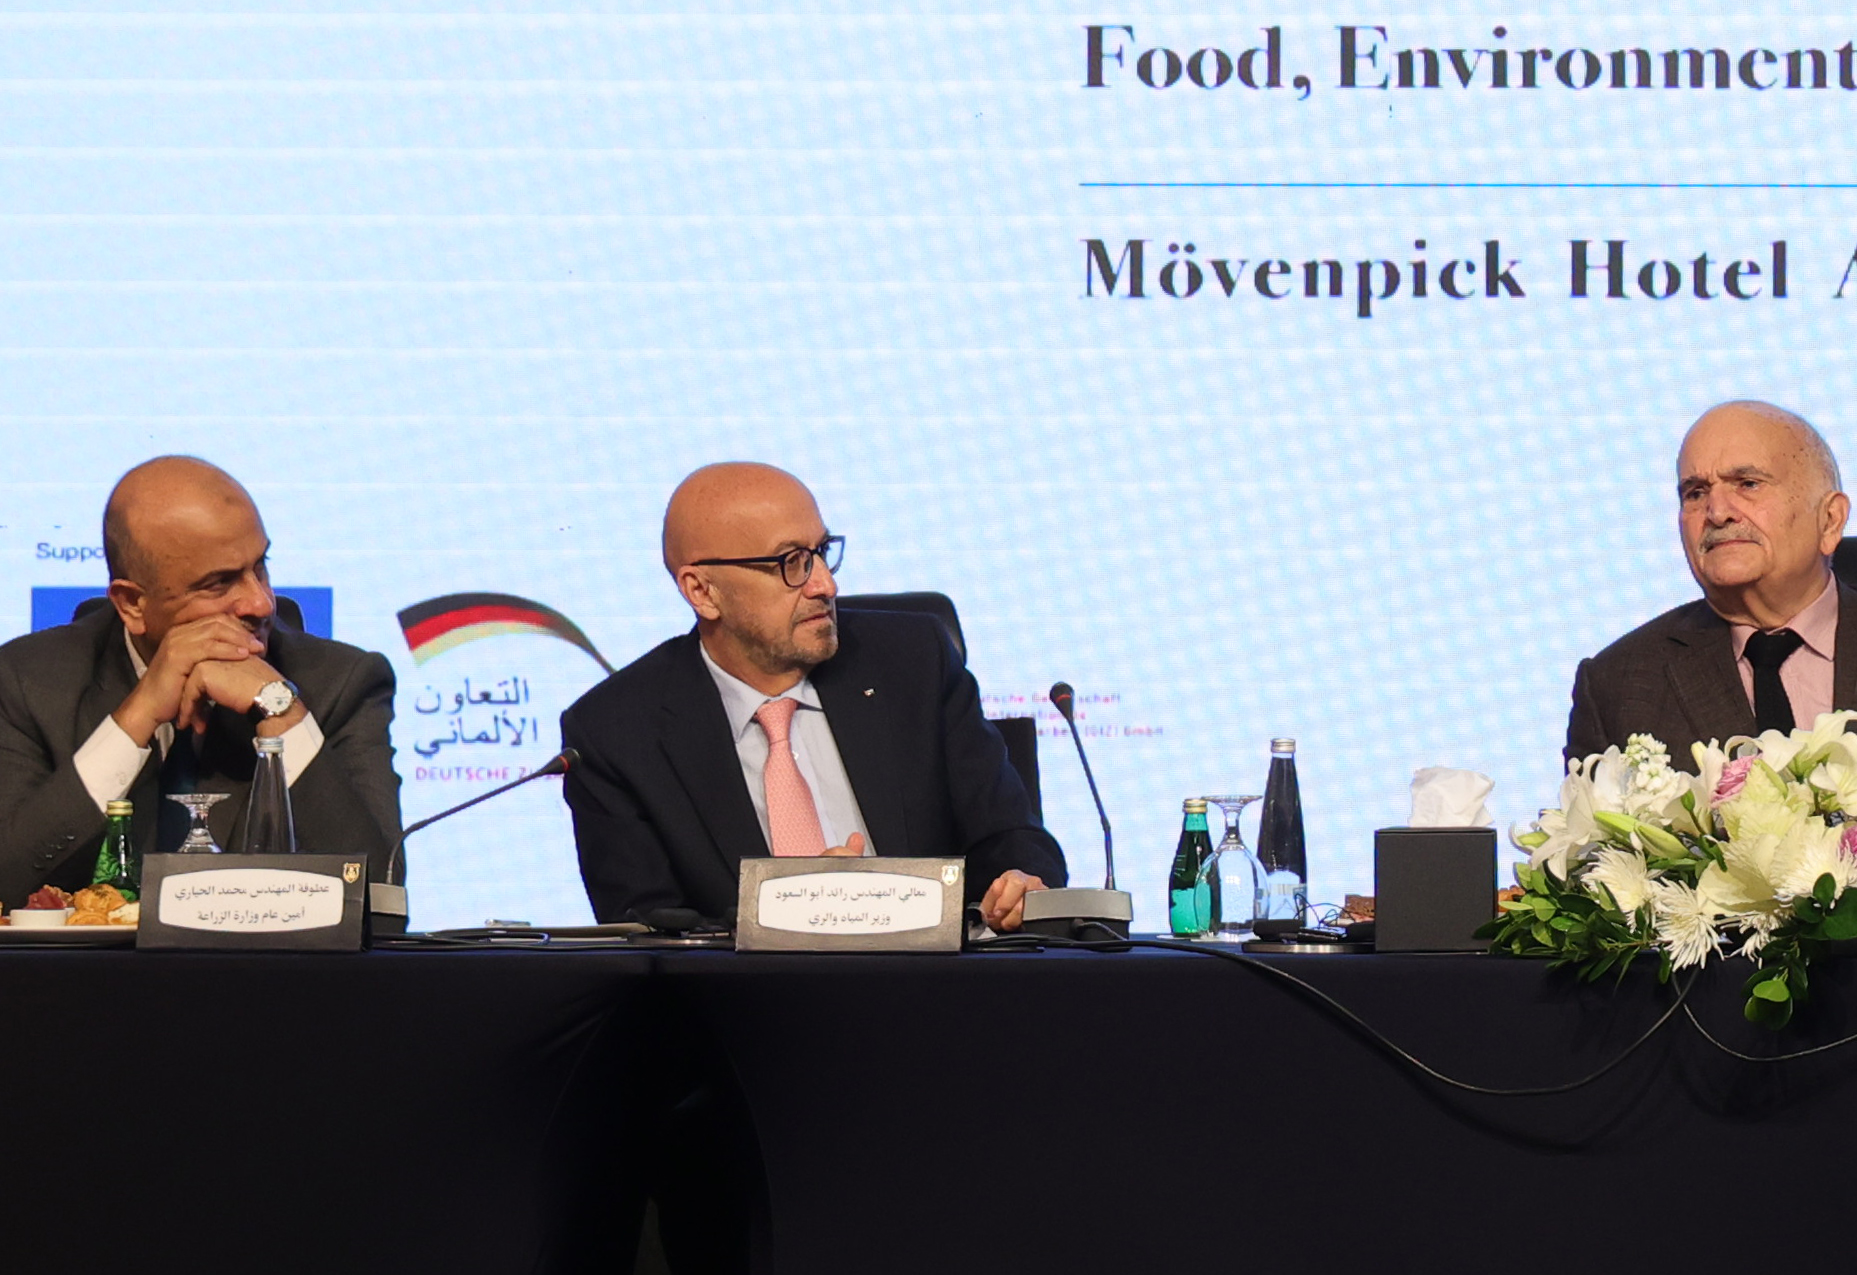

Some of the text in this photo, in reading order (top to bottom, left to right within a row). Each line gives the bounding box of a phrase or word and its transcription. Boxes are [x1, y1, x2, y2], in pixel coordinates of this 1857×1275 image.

[1085, 24, 1312, 100] Food,
[1085, 236, 1526, 320] Mövenpick
[1569, 238, 1788, 302] Hotel
[35, 541, 107, 563] Suppo
[414, 675, 530, 714] التعاون
[413, 709, 538, 760] الألماني
[415, 766, 511, 781] DEUTSCHE
[217, 886, 247, 895] محمد
[250, 883, 295, 898] المهندس
[298, 883, 330, 898] عطوفة
[775, 887, 807, 902] السعود
[850, 887, 895, 902] المهندس
[898, 887, 926, 903] معالي
[197, 909, 231, 924] الزراعة
[233, 910, 259, 924] وزارة
[261, 910, 278, 924] عام
[808, 912, 891, 927] وزير المياه والري
